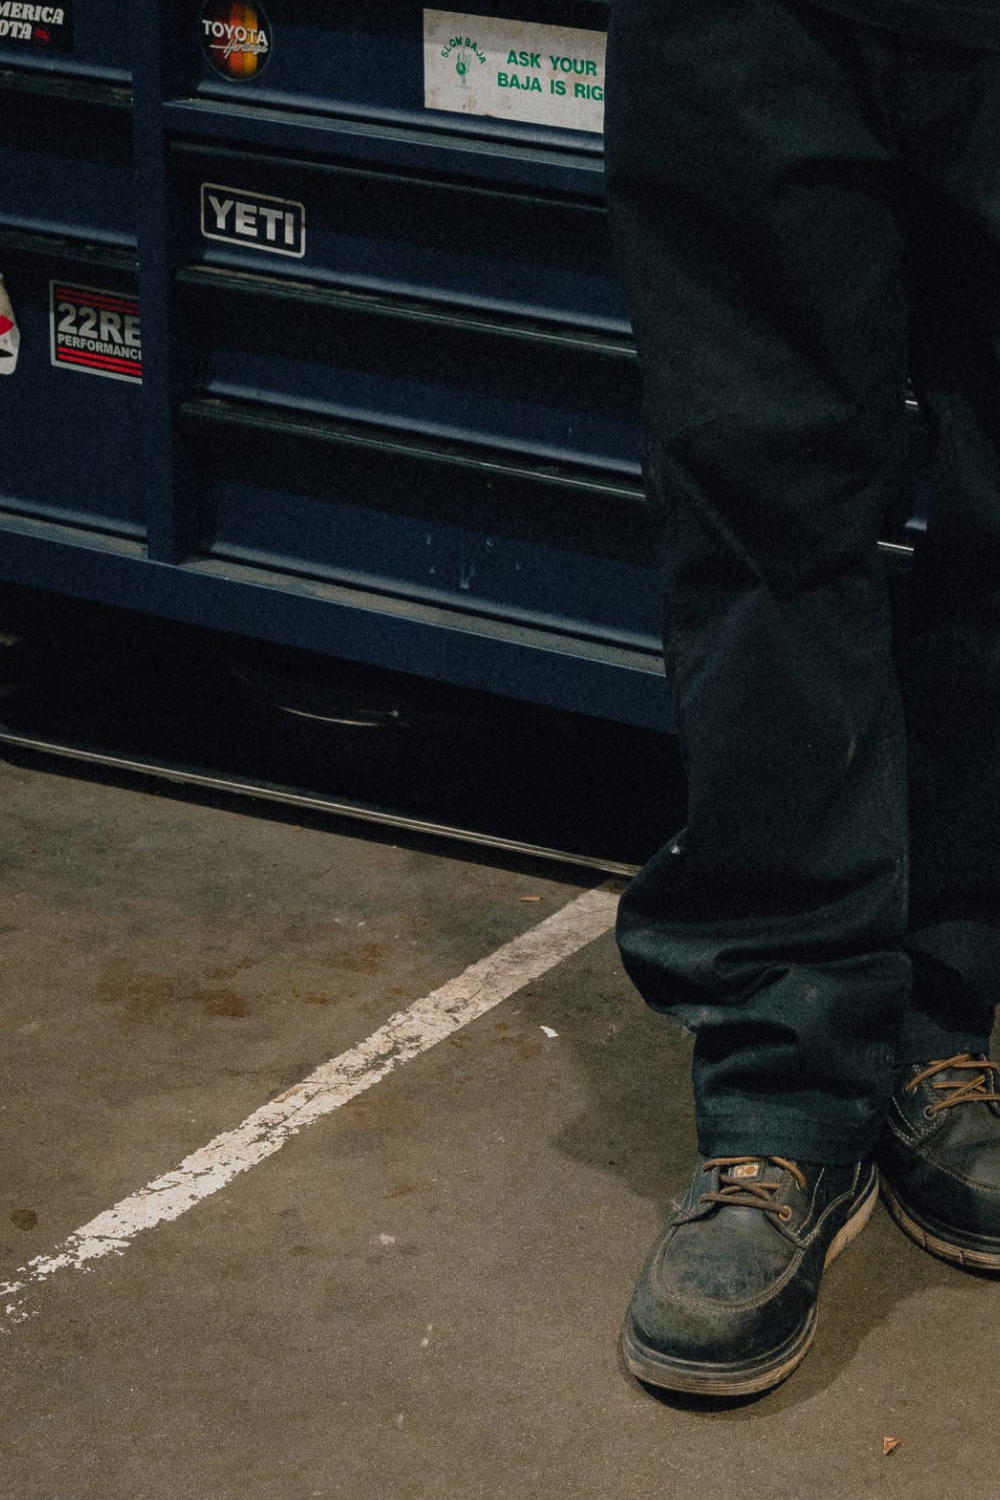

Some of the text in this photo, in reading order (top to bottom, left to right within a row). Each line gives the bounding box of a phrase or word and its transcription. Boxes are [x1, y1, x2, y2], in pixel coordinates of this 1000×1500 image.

[201, 19, 269, 47] TOYOTA
[440, 35, 487, 65] SLOW BAJA
[506, 49, 598, 76] ASK YOUR
[497, 72, 604, 101] BAJA IS RIG
[207, 195, 295, 245] YETI
[57, 302, 142, 347] 22RE
[57, 333, 142, 360] PERFORMANC
